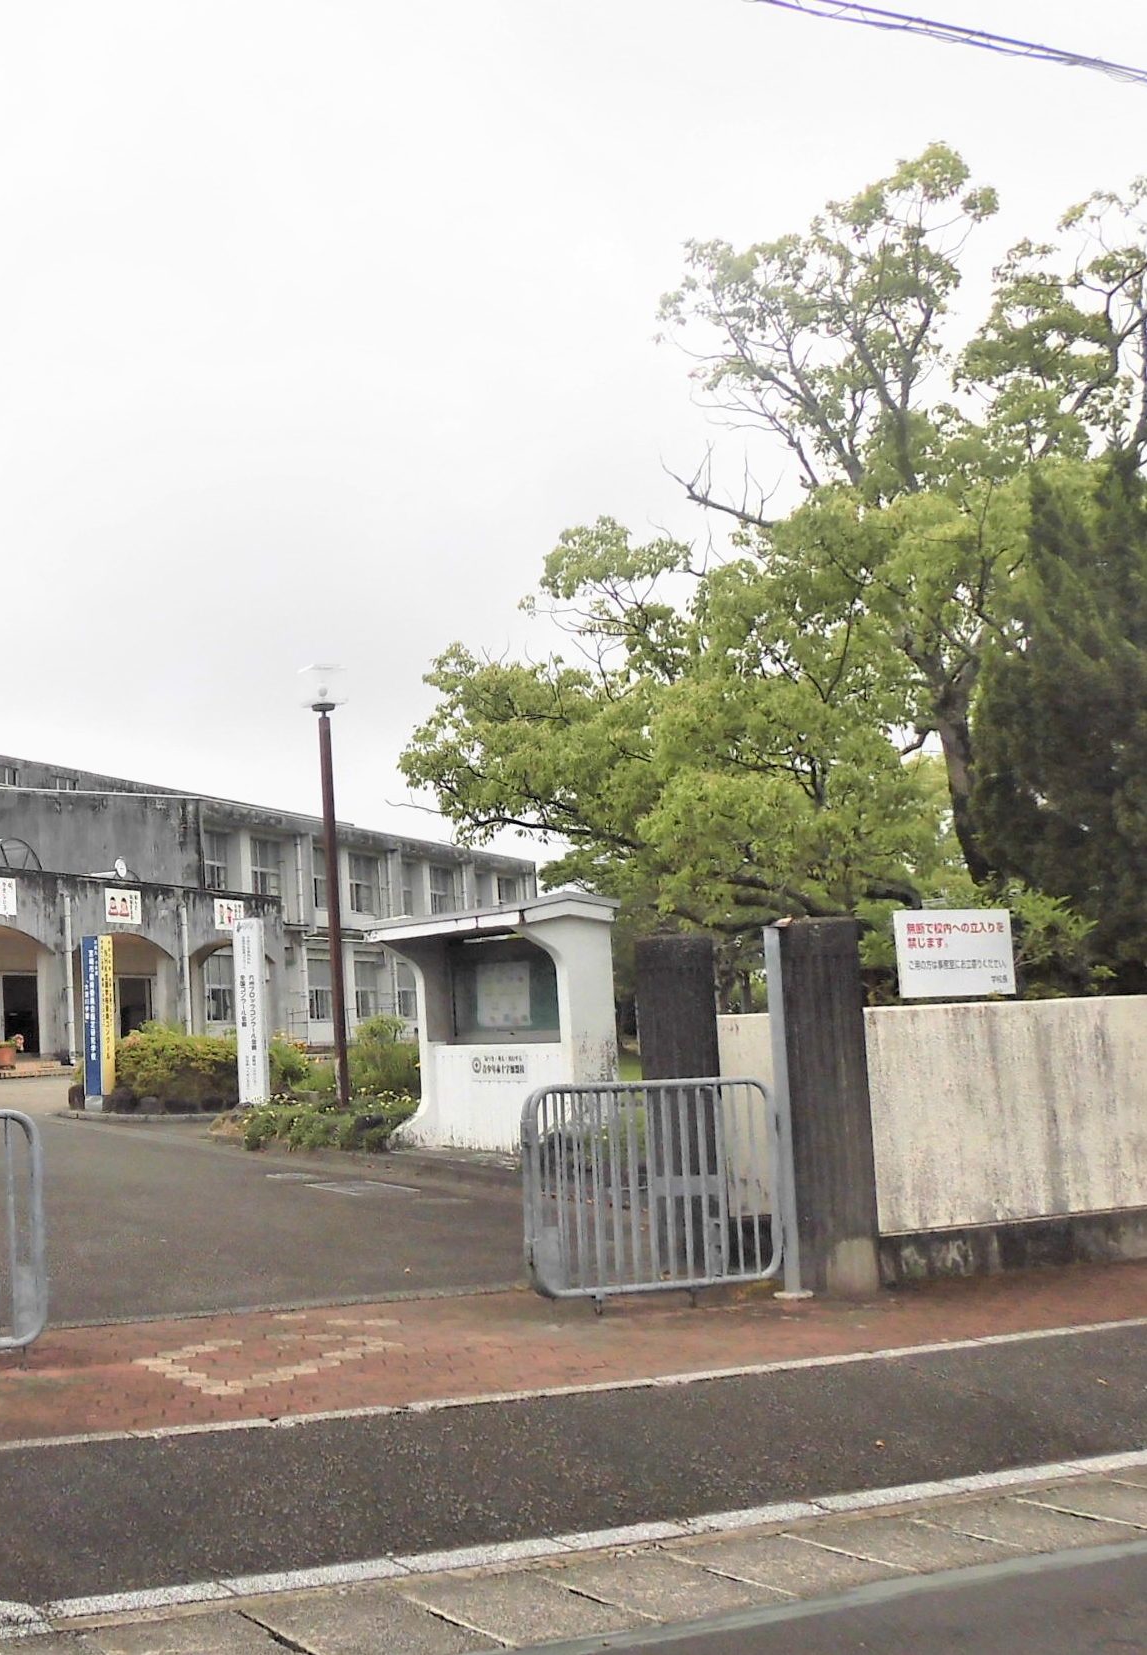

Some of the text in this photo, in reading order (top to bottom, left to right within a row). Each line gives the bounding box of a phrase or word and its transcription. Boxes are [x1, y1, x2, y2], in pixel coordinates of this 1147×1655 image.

[906, 922, 1005, 935] 無断で校内への立入りを
